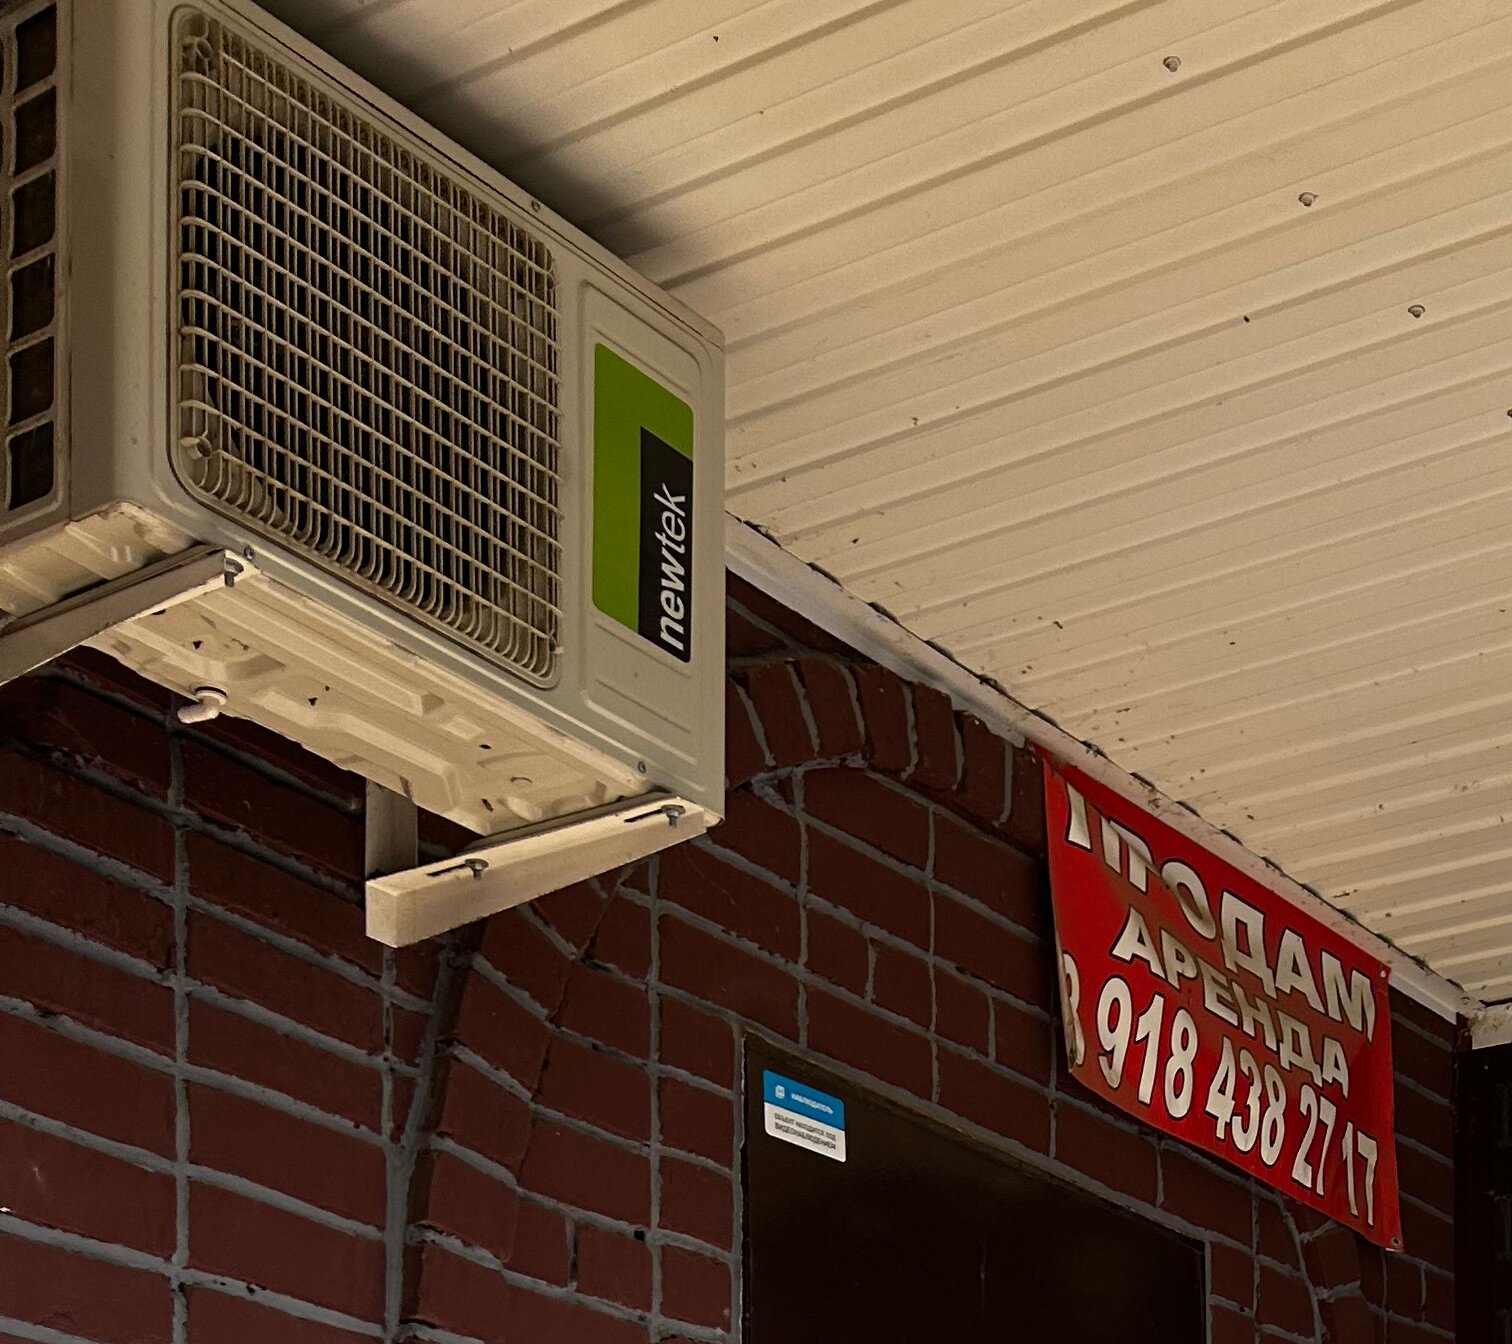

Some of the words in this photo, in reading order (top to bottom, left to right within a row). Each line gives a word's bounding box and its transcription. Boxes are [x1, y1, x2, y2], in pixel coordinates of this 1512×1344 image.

[653, 482, 687, 651] newtek
[1111, 906, 1349, 1099] АРЕНДА
[1097, 976, 1198, 1118] 918
[1205, 1035, 1287, 1166] 438
[1291, 1084, 1337, 1196] 27
[1341, 1120, 1378, 1226] 17
